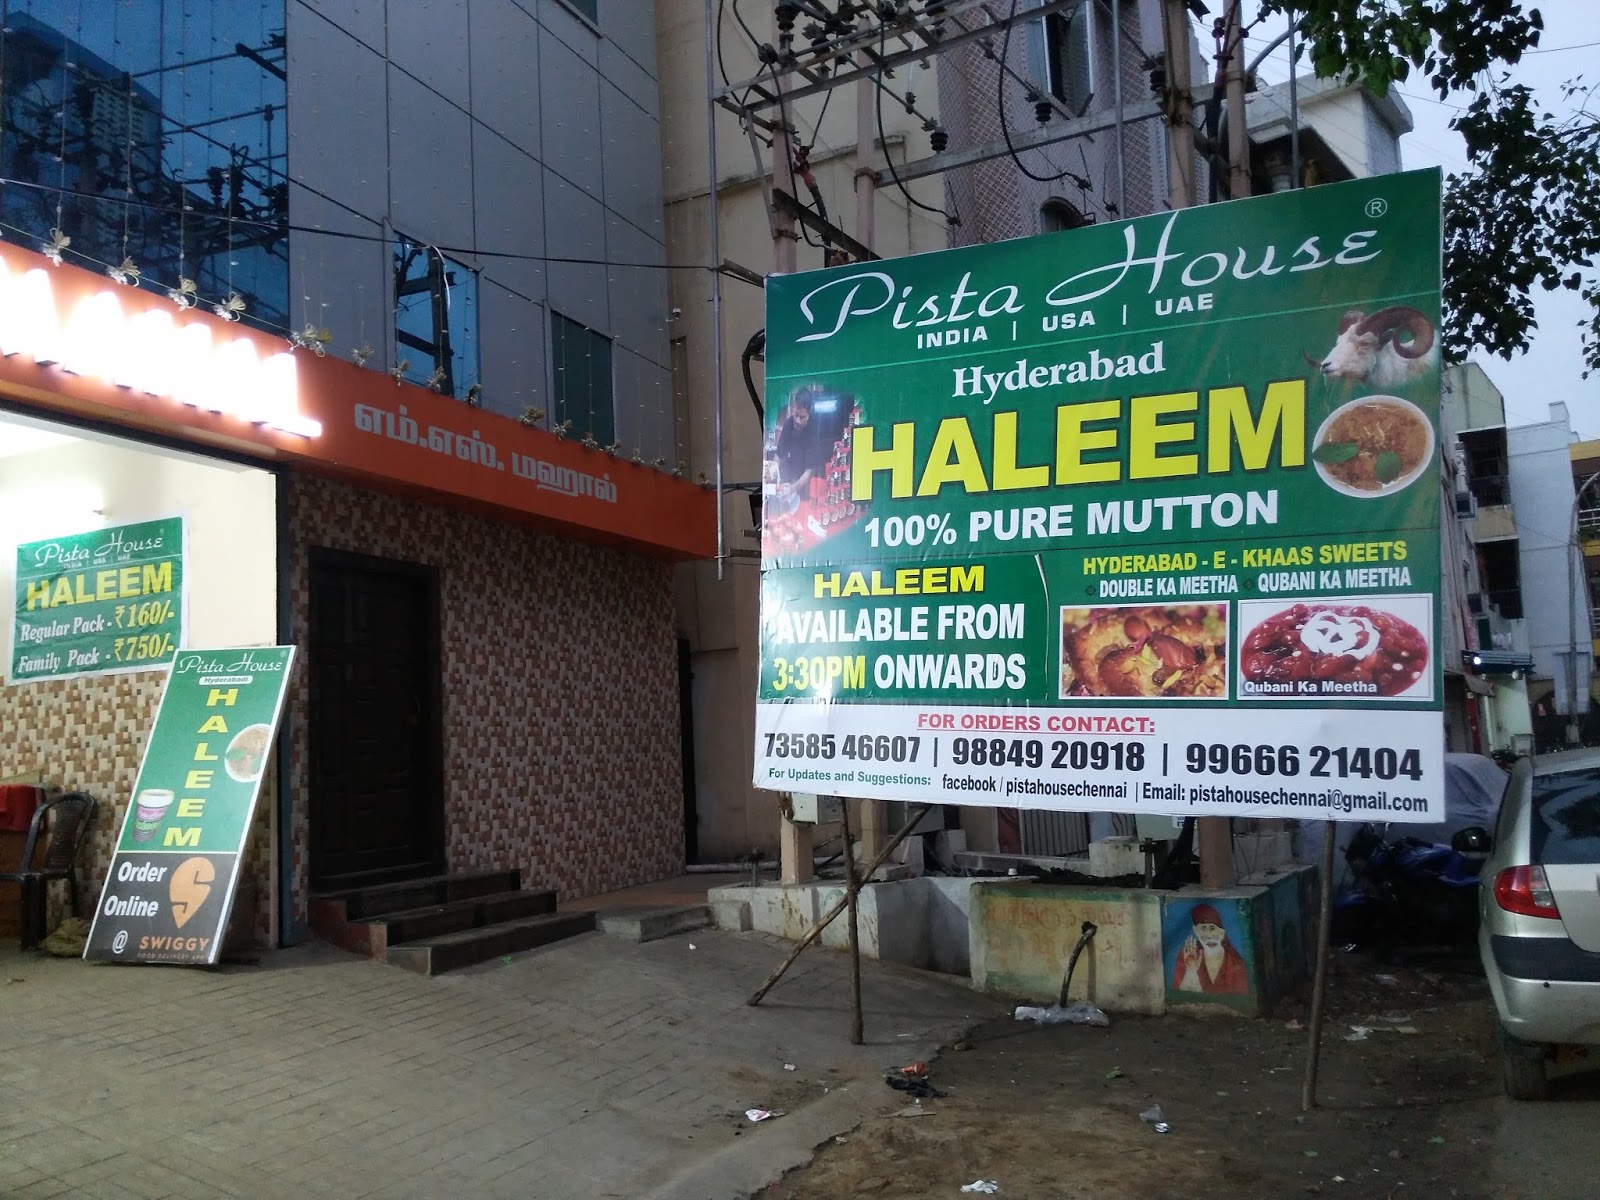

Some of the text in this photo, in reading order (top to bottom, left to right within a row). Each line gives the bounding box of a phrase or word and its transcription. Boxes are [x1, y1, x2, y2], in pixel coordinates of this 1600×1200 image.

[796, 209, 1382, 342] Pista House
[917, 292, 1214, 349] INDIA USA UAE
[952, 340, 1166, 405] Hyderabad
[851, 379, 1306, 501] HALEEM
[864, 489, 1279, 548] 100% PURE MUTTON
[35, 529, 163, 567] Pista House
[1083, 552, 1197, 575] HYDERABAD
[1213, 551, 1225, 569] E
[1242, 546, 1313, 568] KHAAS
[1319, 541, 1407, 564] SWEETS
[26, 561, 172, 611] HALEEM
[813, 565, 985, 599] HALEEM
[1099, 575, 1238, 598] DOUBLE KA MEETHA
[1258, 567, 1412, 592] QUBANI KA MEETHA
[20, 620, 70, 644] Regular
[776, 603, 1025, 645] AVAILABLE FROM
[18, 652, 60, 673] Family
[67, 647, 100, 667] Pack
[176, 651, 282, 673] Pista House
[773, 653, 1026, 691] 3:30PM ONWARDS
[1244, 681, 1377, 694] Qubani Ka Meetha
[917, 713, 1155, 733] FOR ORDERS CONTACT:
[764, 732, 1423, 782] 73585 46607 98849 20918 99666 21404
[769, 768, 785, 779] For
[788, 769, 832, 781] Updates
[834, 771, 854, 782] and
[857, 771, 931, 786] Suggestions:
[942, 774, 996, 793] facebook
[1006, 779, 1127, 798] pistahousechennai
[1143, 783, 1428, 813] Email: pistahousechennai@gmail.com
[118, 861, 167, 882] Order
[104, 895, 159, 917] Online
[112, 930, 210, 954] @ SWIGGY
